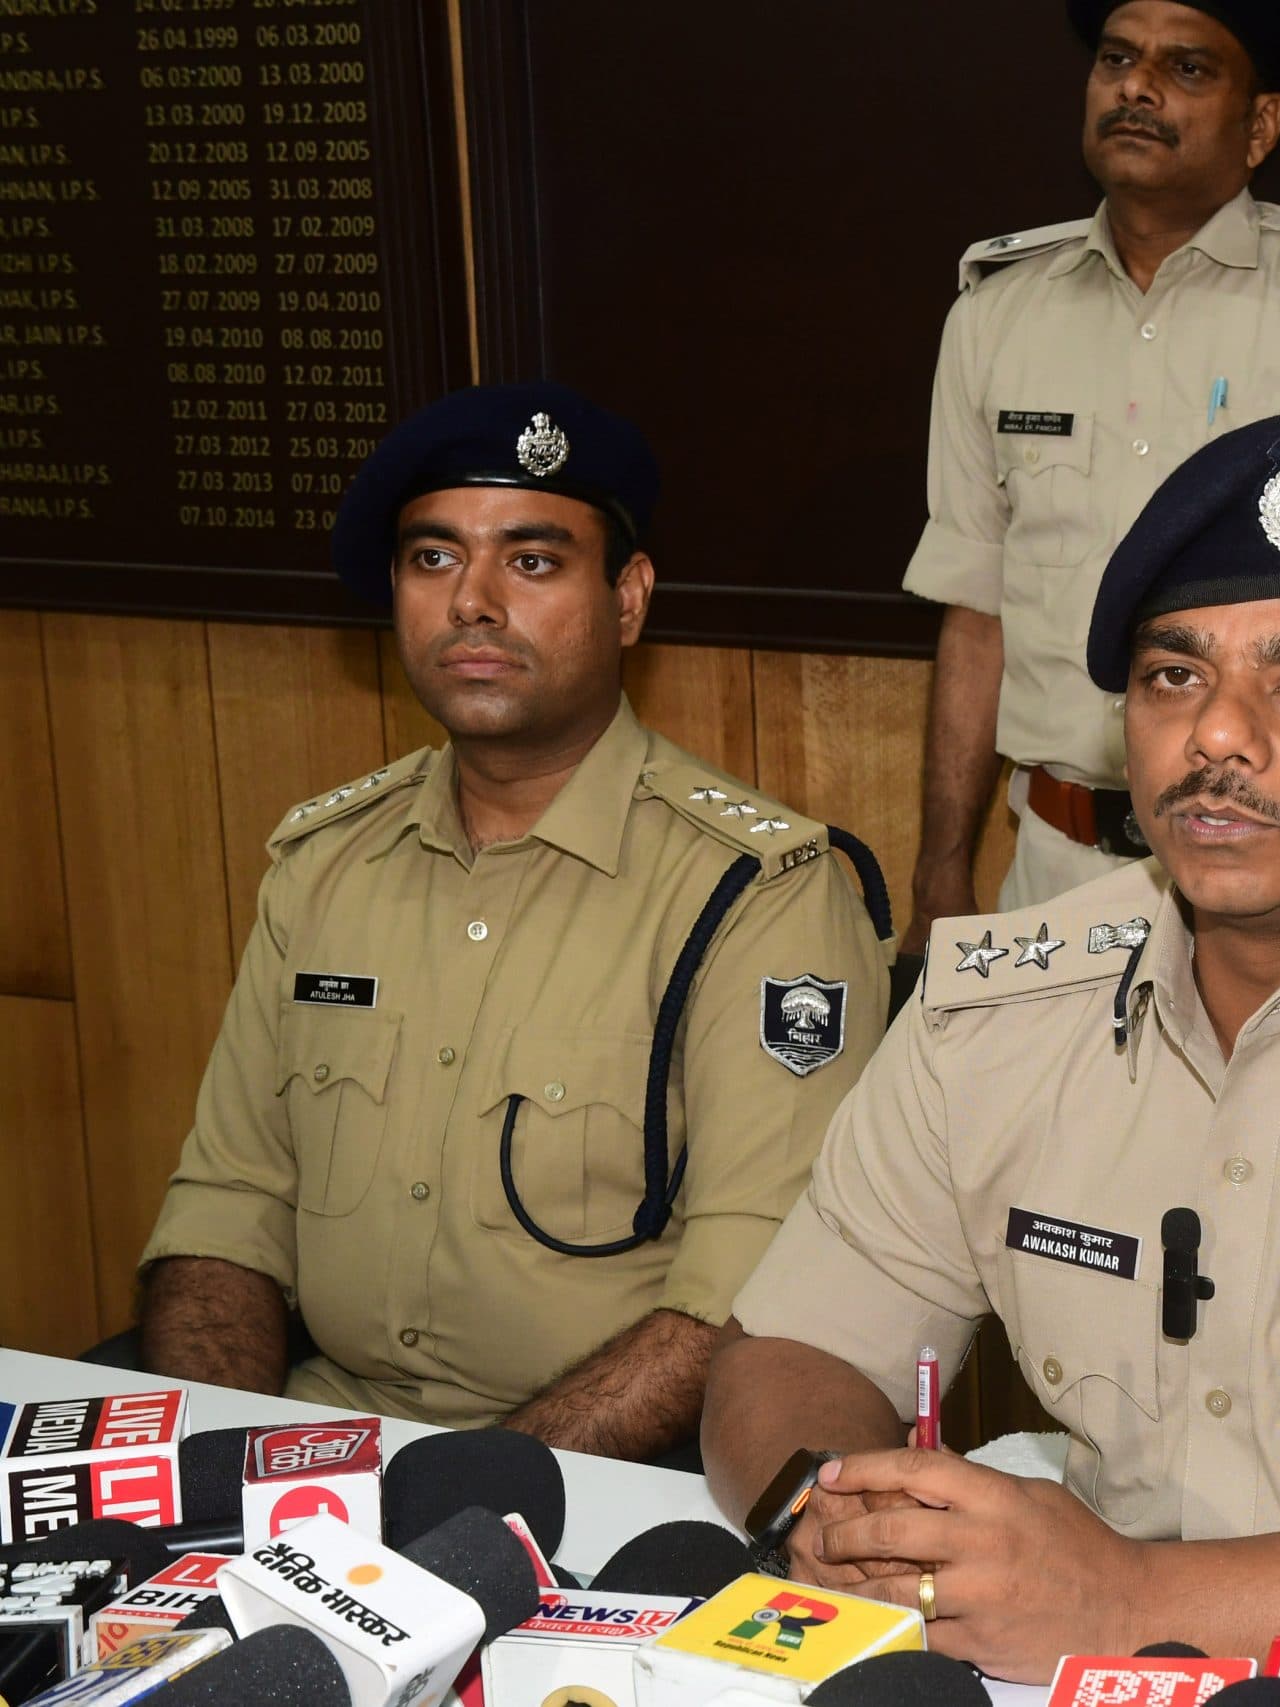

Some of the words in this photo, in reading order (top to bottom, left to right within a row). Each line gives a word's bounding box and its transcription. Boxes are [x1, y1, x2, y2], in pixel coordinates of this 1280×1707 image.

[138, 28, 239, 50] 26.04.1999
[257, 23, 361, 48] 06.03.2000
[141, 66, 242, 88] 06.03.2000
[260, 62, 365, 86] 13.03.2000
[145, 104, 246, 126] 13.03.2000
[263, 101, 368, 124] 19.12.2003
[149, 142, 249, 163] 20.12.2003
[266, 140, 370, 162] 12.09.2005
[152, 179, 252, 201] 12.09.2005
[269, 178, 373, 200] 31.03.2008
[156, 217, 255, 238] 31.03.2008
[272, 216, 376, 237] 17.02.2009
[159, 254, 258, 275] 18.02.2009
[275, 253, 378, 275] 27.07.2009
[162, 291, 261, 312] 27.07.2009
[279, 291, 381, 312] 19.04.2010
[165, 328, 264, 349] 19.04.2010
[281, 328, 384, 350] 08.08.2010
[168, 363, 266, 385] 08.08.2010
[284, 364, 385, 387] 12.02.2011
[172, 399, 268, 421] 12.02.2011
[287, 401, 388, 424] 27.03.2012
[175, 435, 271, 457] 27.03.2012
[290, 438, 376, 459] 25.03.201
[177, 470, 273, 493] 27.03.2013
[180, 506, 275, 528] 07.10.2014
[309, 990, 341, 1001] ATULESH
[341, 993, 356, 1002] JHA
[787, 1027, 823, 1046] बिहार
[1031, 1219, 1078, 1240] अवकाश
[1079, 1231, 1114, 1249] कुमार
[1021, 1233, 1077, 1260] AWAKASH
[1079, 1247, 1120, 1272] KUMAR
[24, 1401, 90, 1455] MEDIA
[101, 1393, 168, 1447] LIVE
[22, 1473, 79, 1542] ME
[252, 1542, 331, 1594] दैनिक
[320, 1588, 412, 1646] भास्कर
[535, 1603, 638, 1623] NEWS
[641, 1611, 673, 1626] 17
